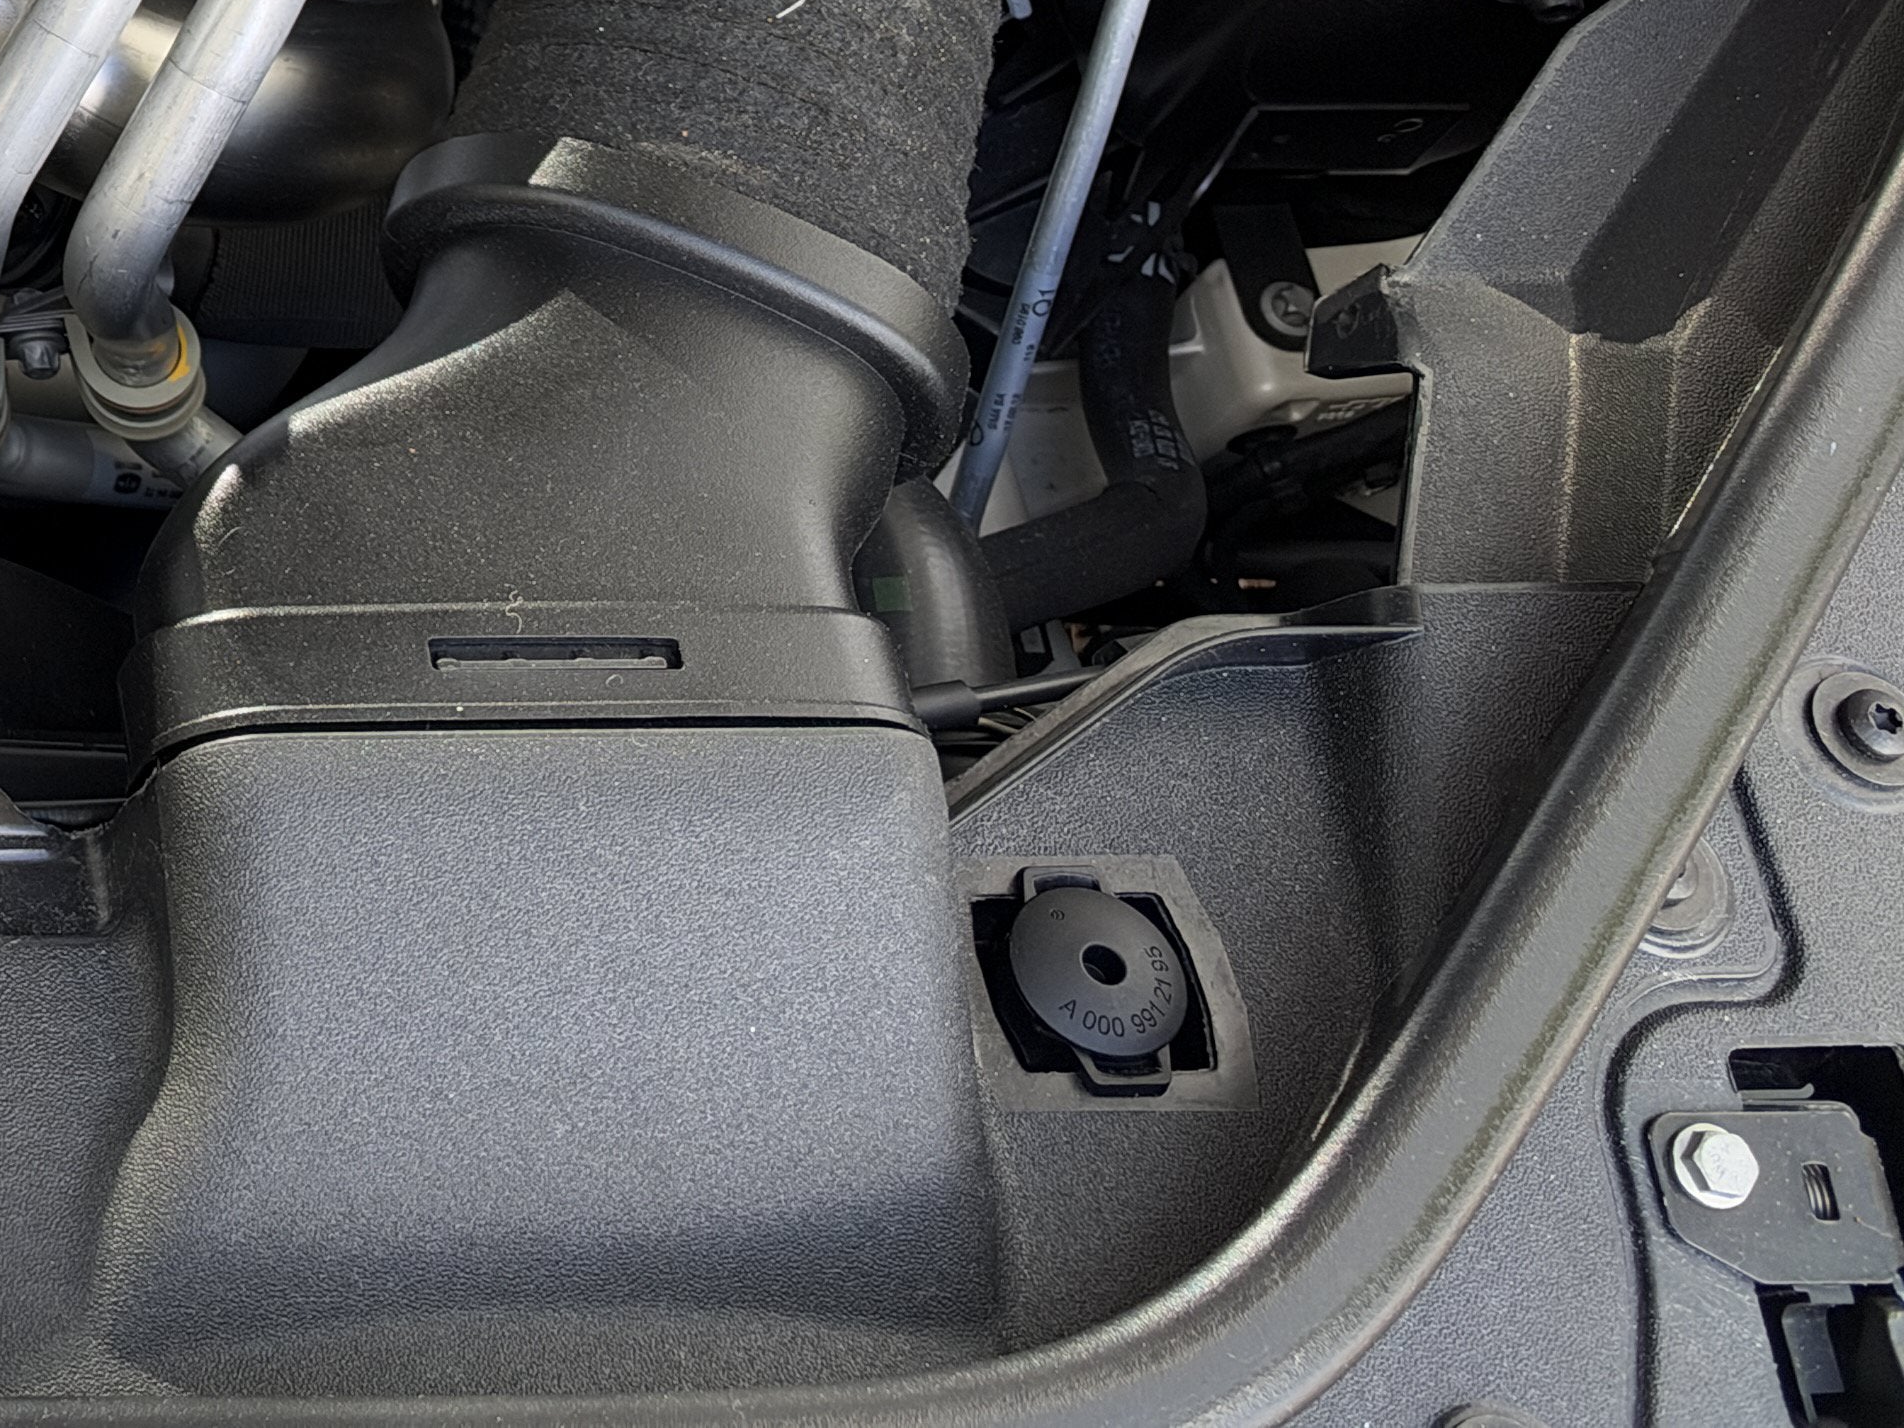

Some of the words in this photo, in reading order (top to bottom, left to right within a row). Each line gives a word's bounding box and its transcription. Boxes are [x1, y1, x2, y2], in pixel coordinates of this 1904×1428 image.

[1144, 945, 1170, 973] 95
[1152, 976, 1173, 1005] 21
[1057, 998, 1077, 1020] A
[1082, 1009, 1125, 1038] 000
[1130, 1000, 1166, 1035] 991
